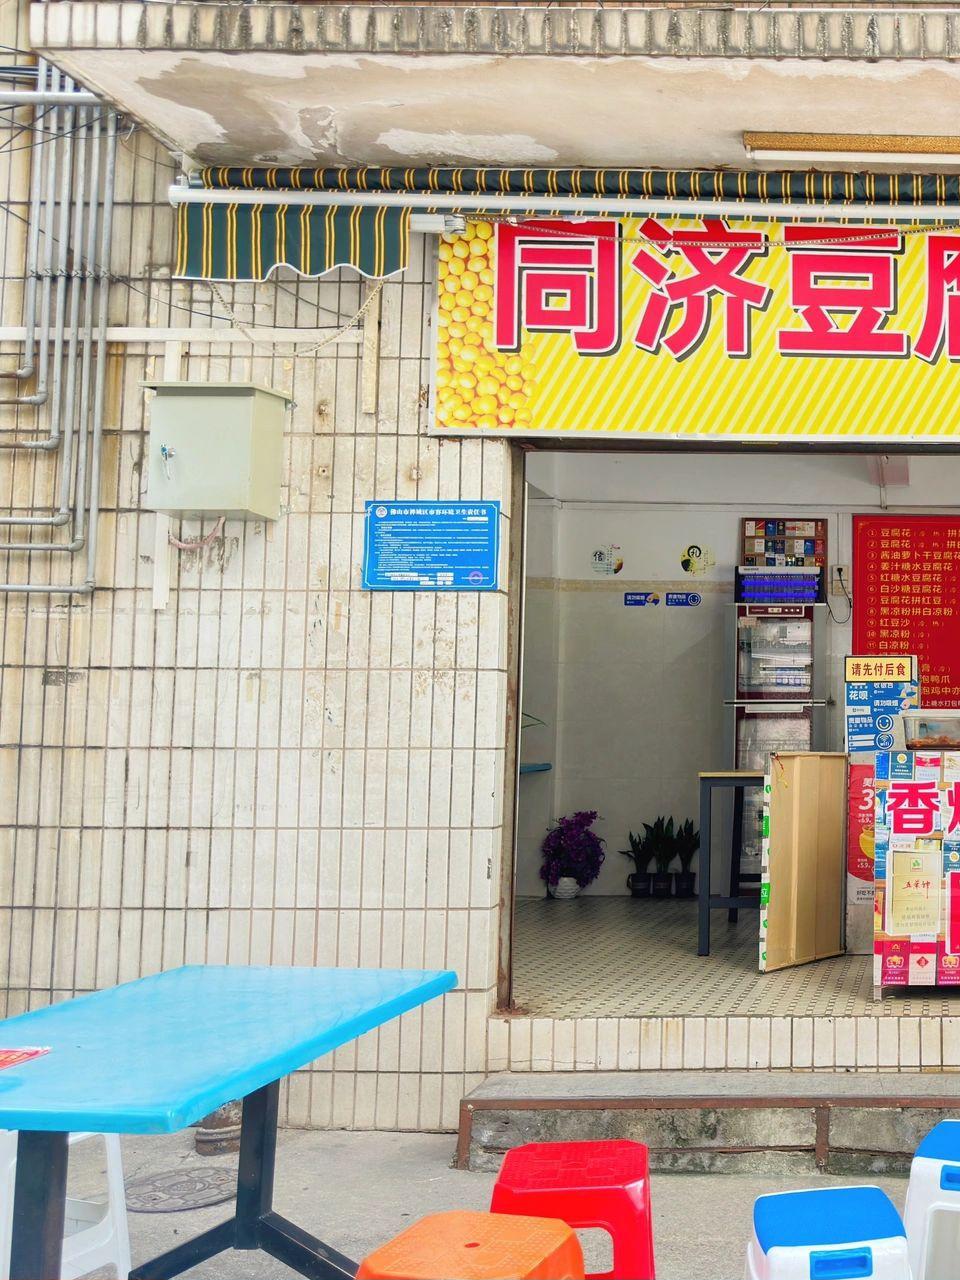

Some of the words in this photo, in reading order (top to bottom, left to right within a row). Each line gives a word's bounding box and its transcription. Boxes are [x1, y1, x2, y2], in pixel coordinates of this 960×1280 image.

[851, 663, 905, 676] 请先付后食
